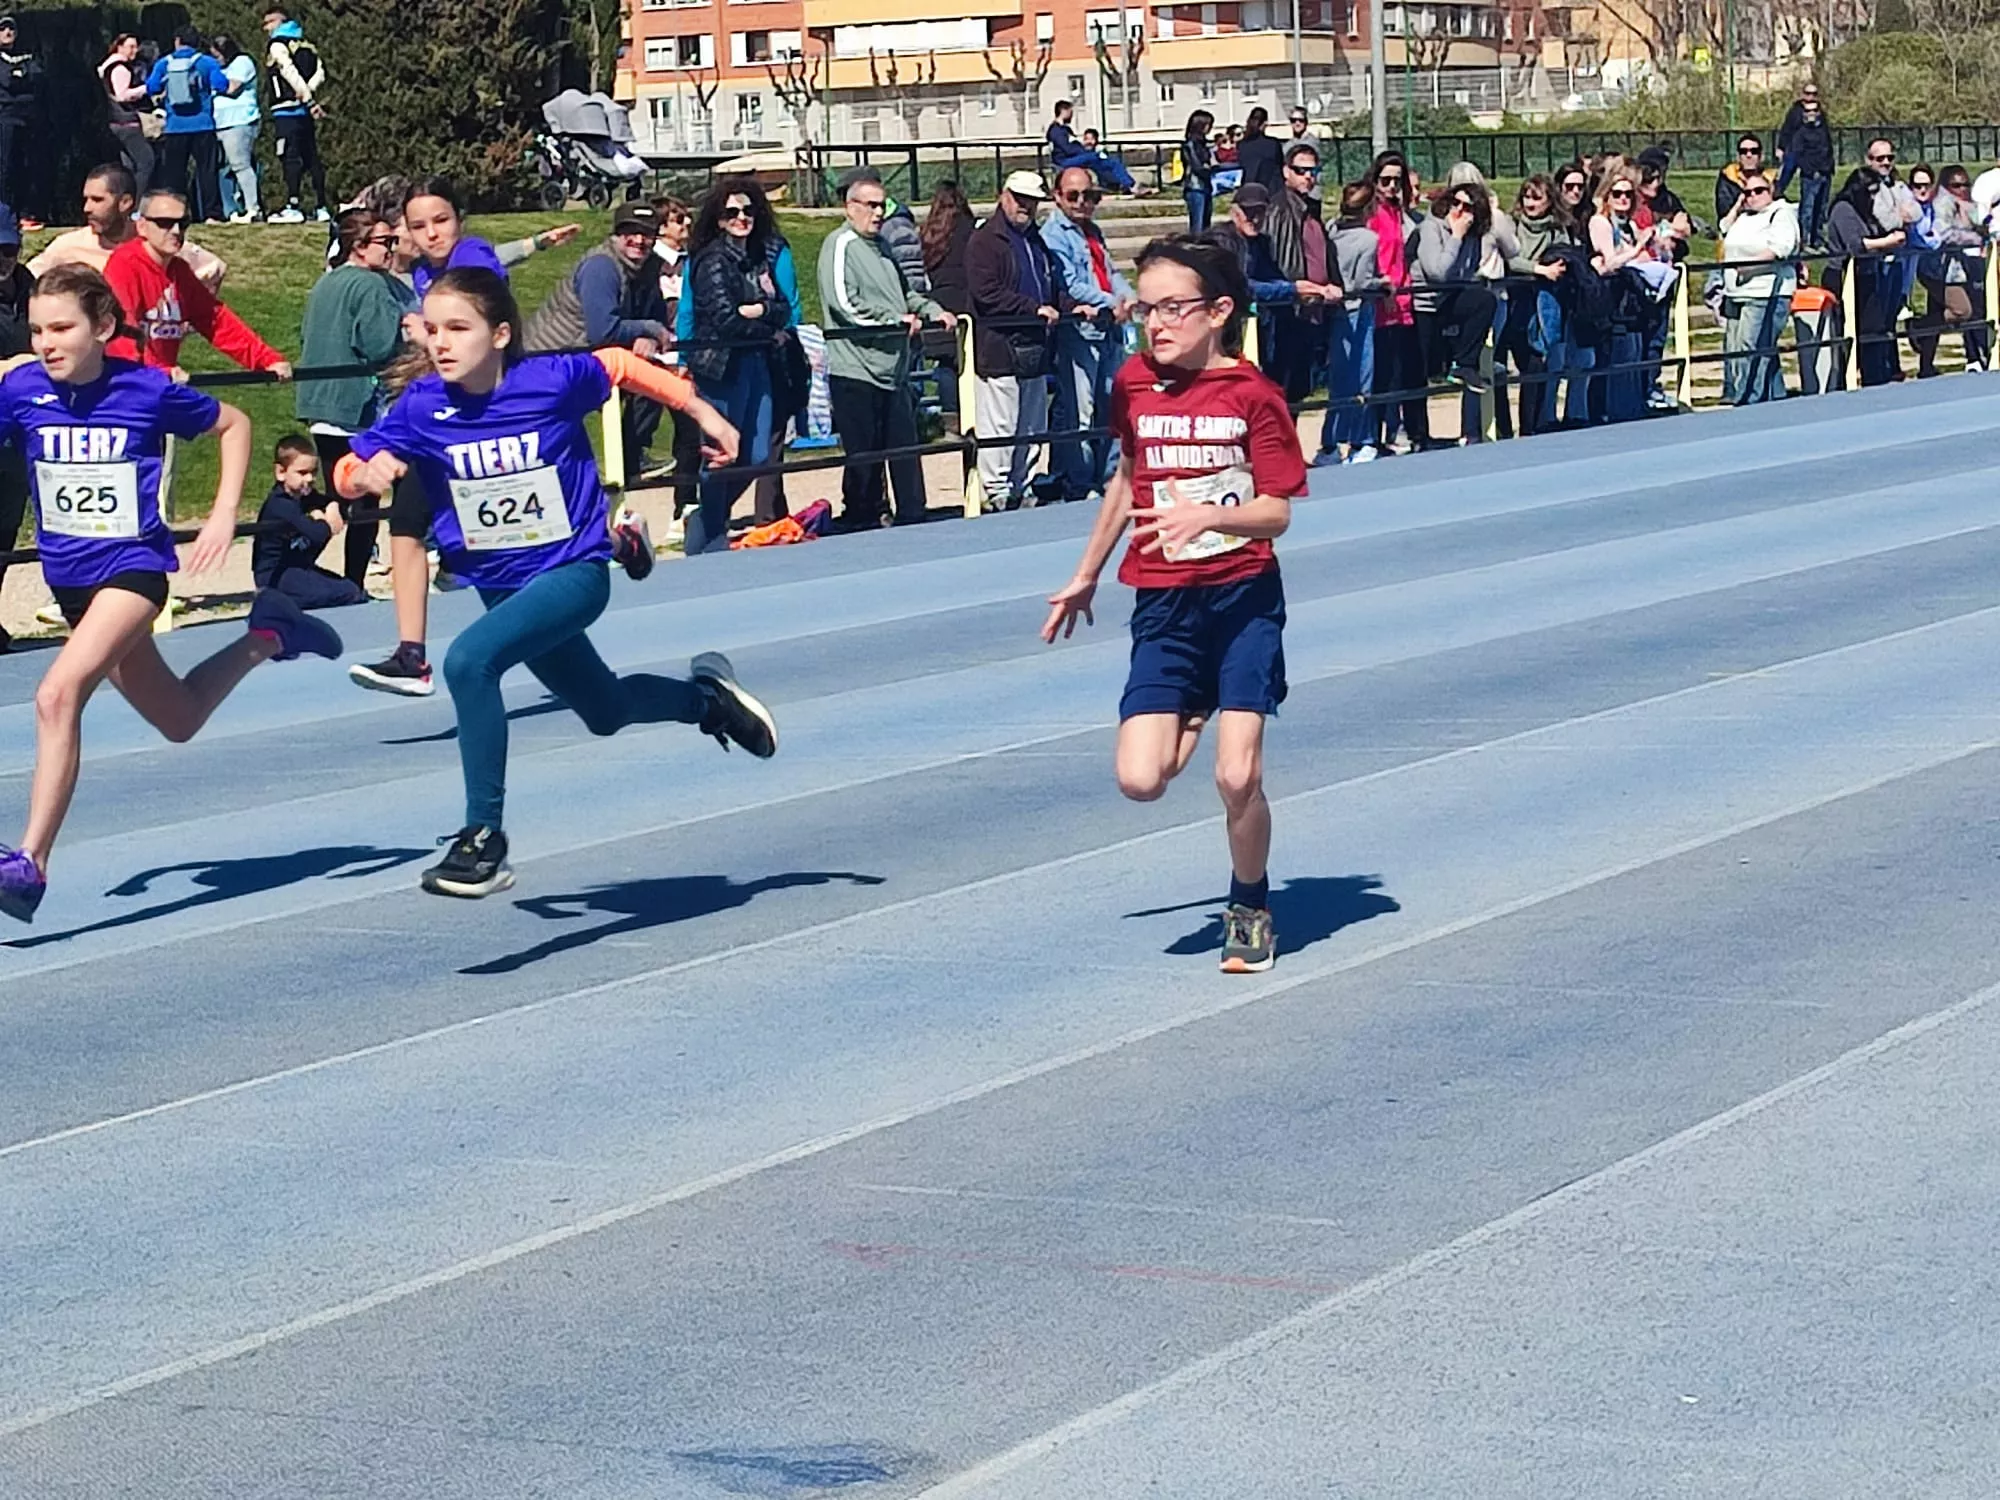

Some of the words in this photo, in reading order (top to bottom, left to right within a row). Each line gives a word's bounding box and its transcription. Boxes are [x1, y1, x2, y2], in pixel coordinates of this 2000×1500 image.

[36, 426, 129, 463] TIERZ
[1138, 415, 1191, 440] SANTOS
[444, 431, 544, 480] TIERZ
[56, 486, 118, 513] 625
[478, 491, 545, 528] 624
